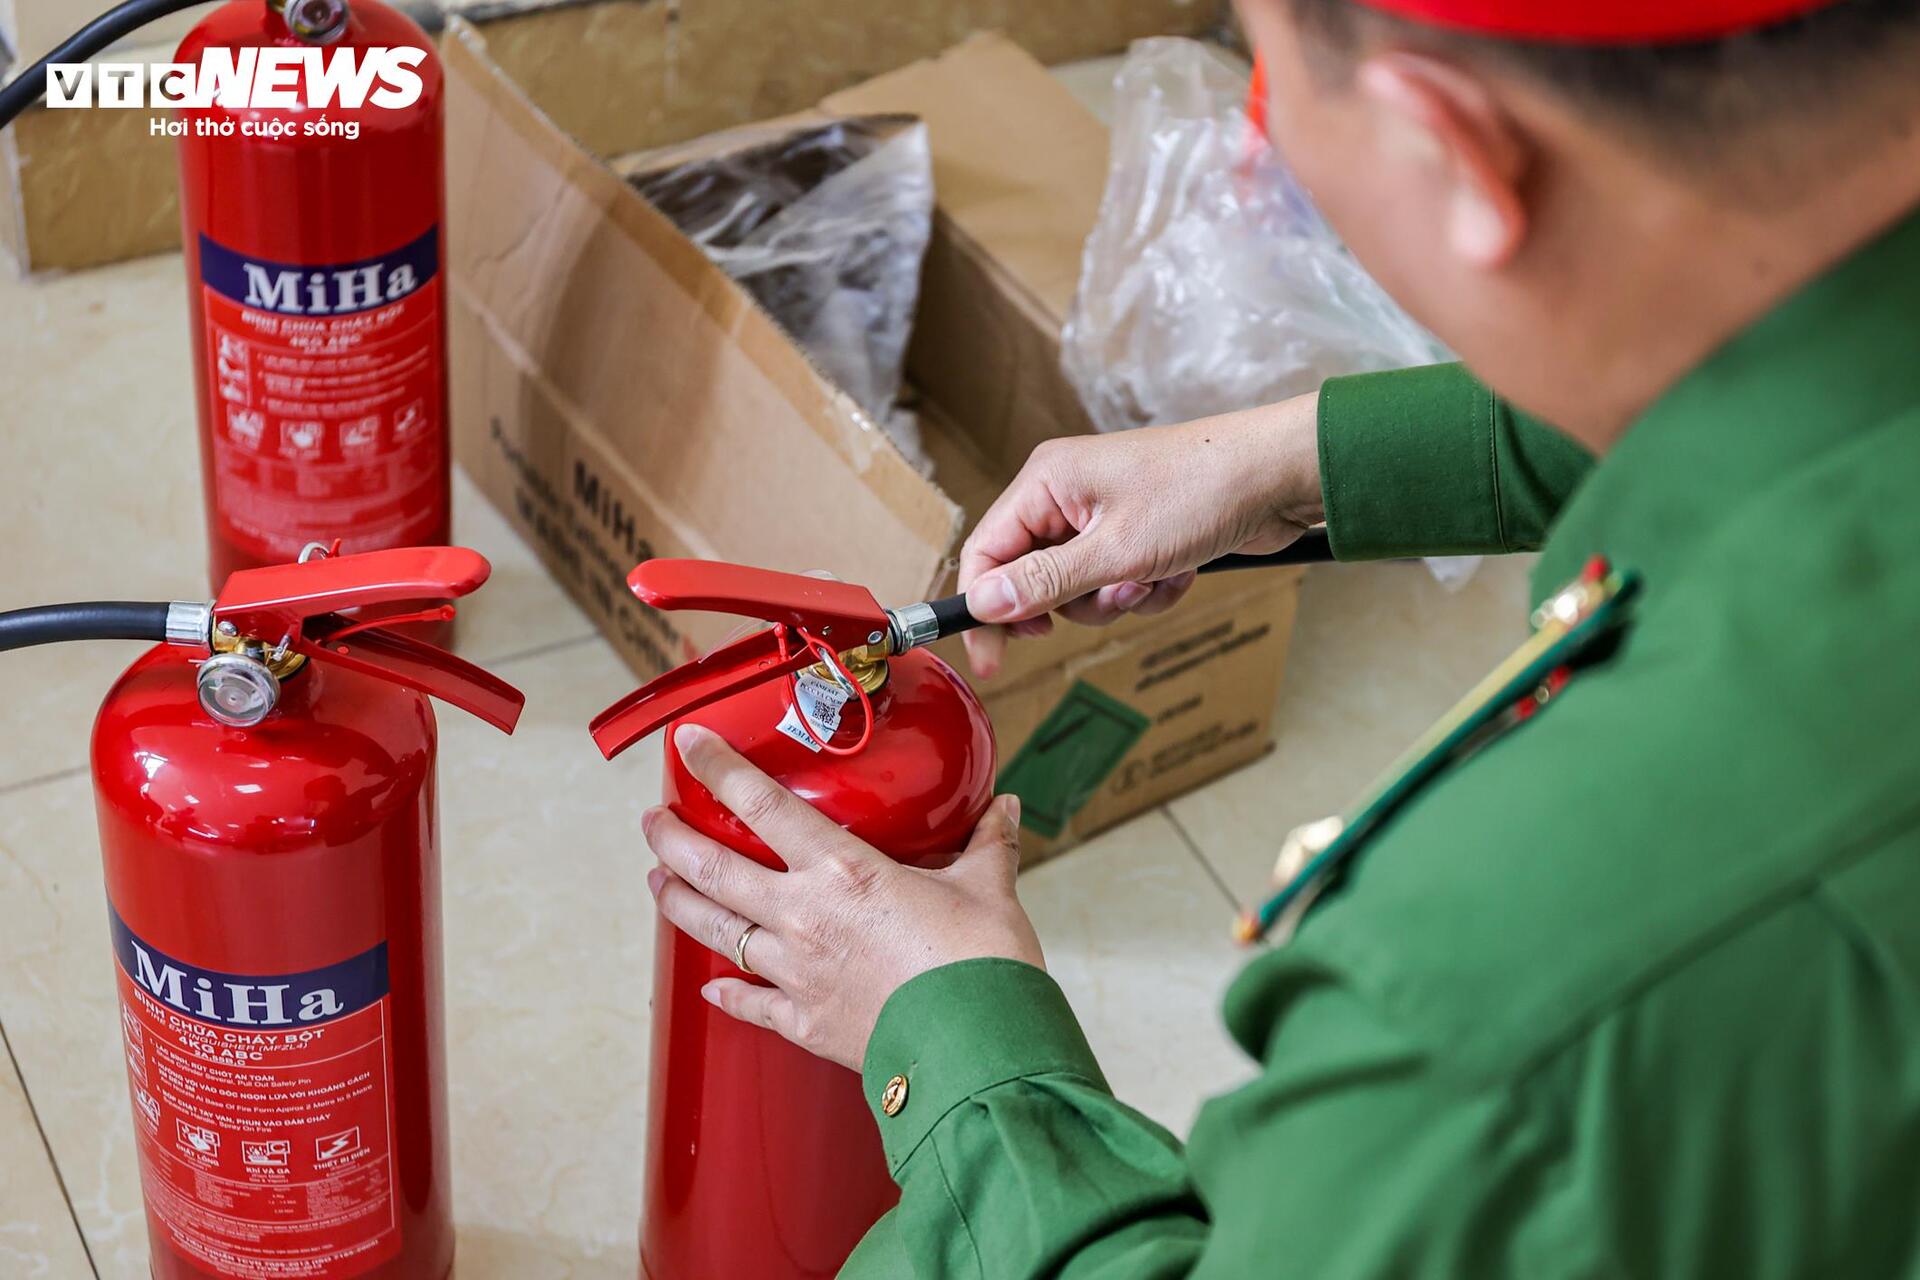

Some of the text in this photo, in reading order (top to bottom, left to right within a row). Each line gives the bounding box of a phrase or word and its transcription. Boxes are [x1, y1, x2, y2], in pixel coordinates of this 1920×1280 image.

[243, 261, 418, 314] MiHa
[131, 939, 344, 1024] MiHa
[178, 1036, 263, 1060] 4KG ABC
[235, 1072, 247, 1080] AN
